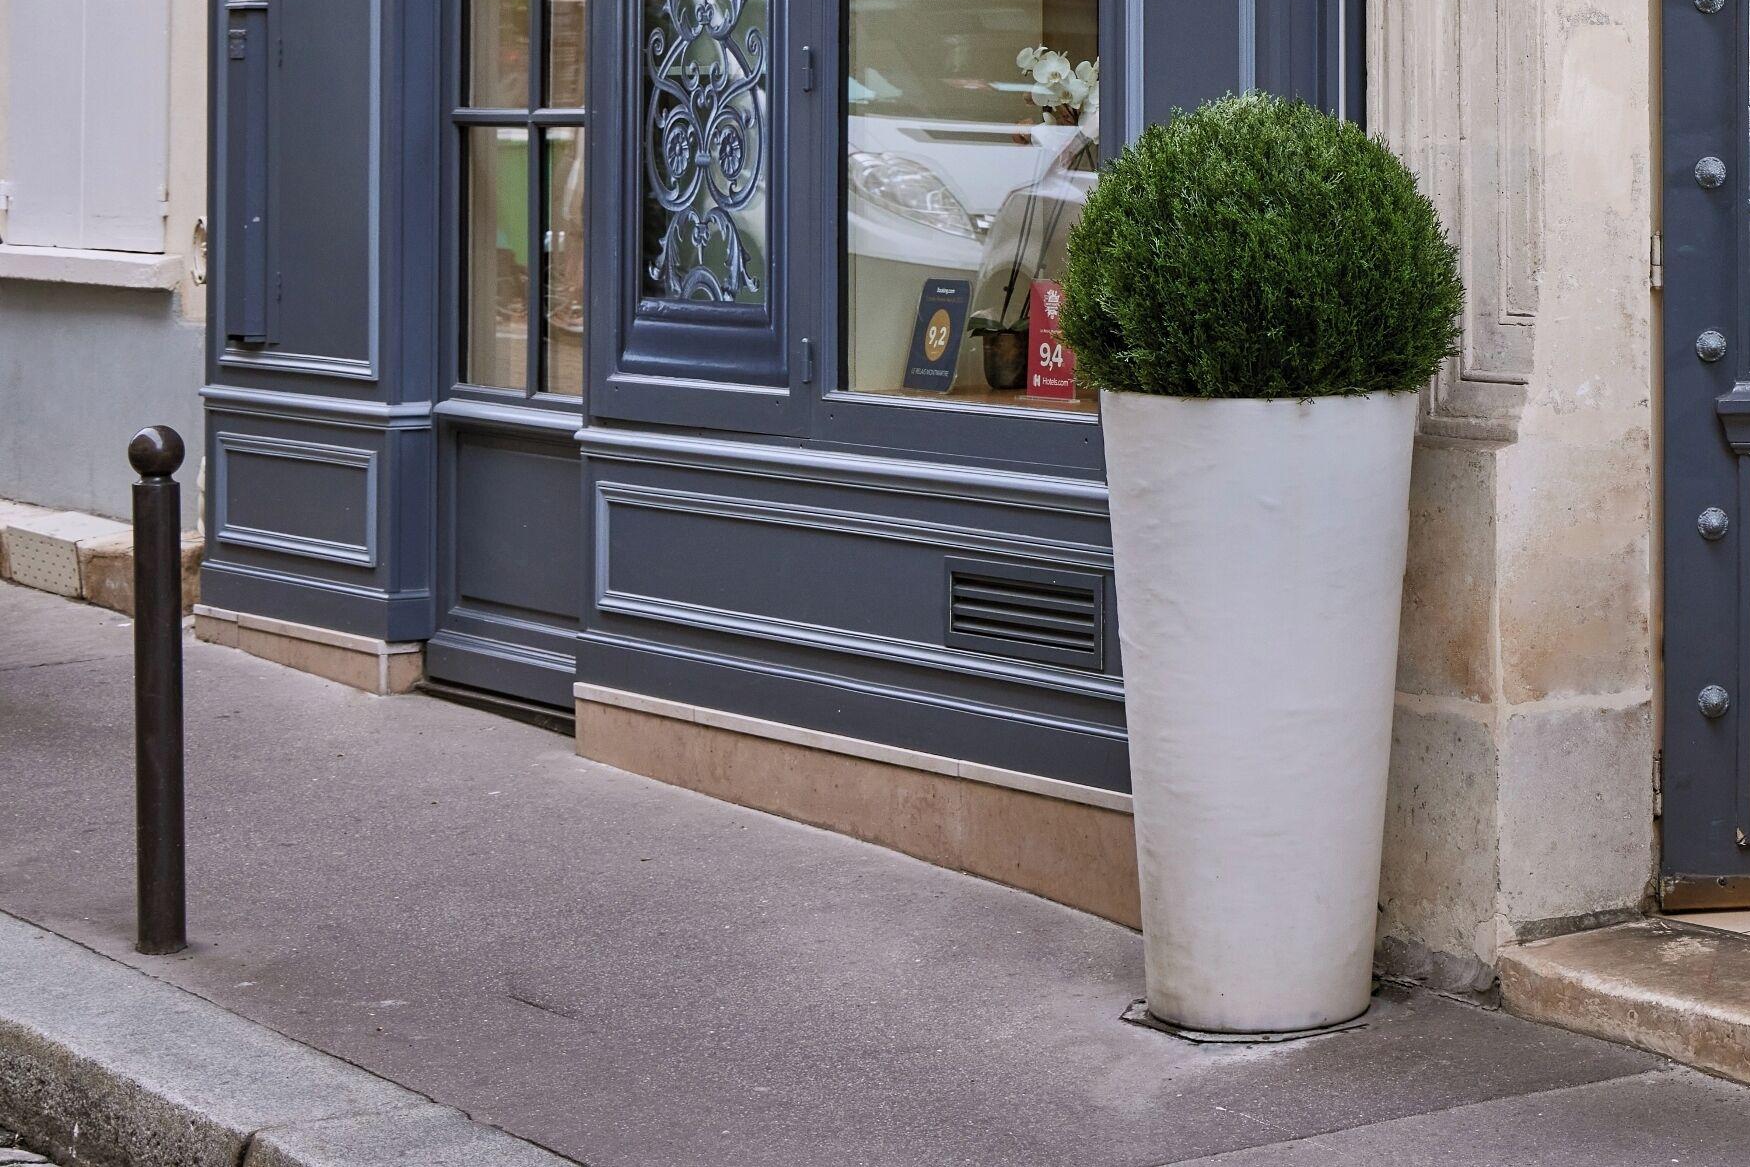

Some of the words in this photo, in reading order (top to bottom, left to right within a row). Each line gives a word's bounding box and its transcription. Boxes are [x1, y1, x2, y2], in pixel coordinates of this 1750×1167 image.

[928, 326, 947, 349] 9,2
[1039, 342, 1064, 372] 9,4
[1042, 377, 1069, 387] Hotels.com
